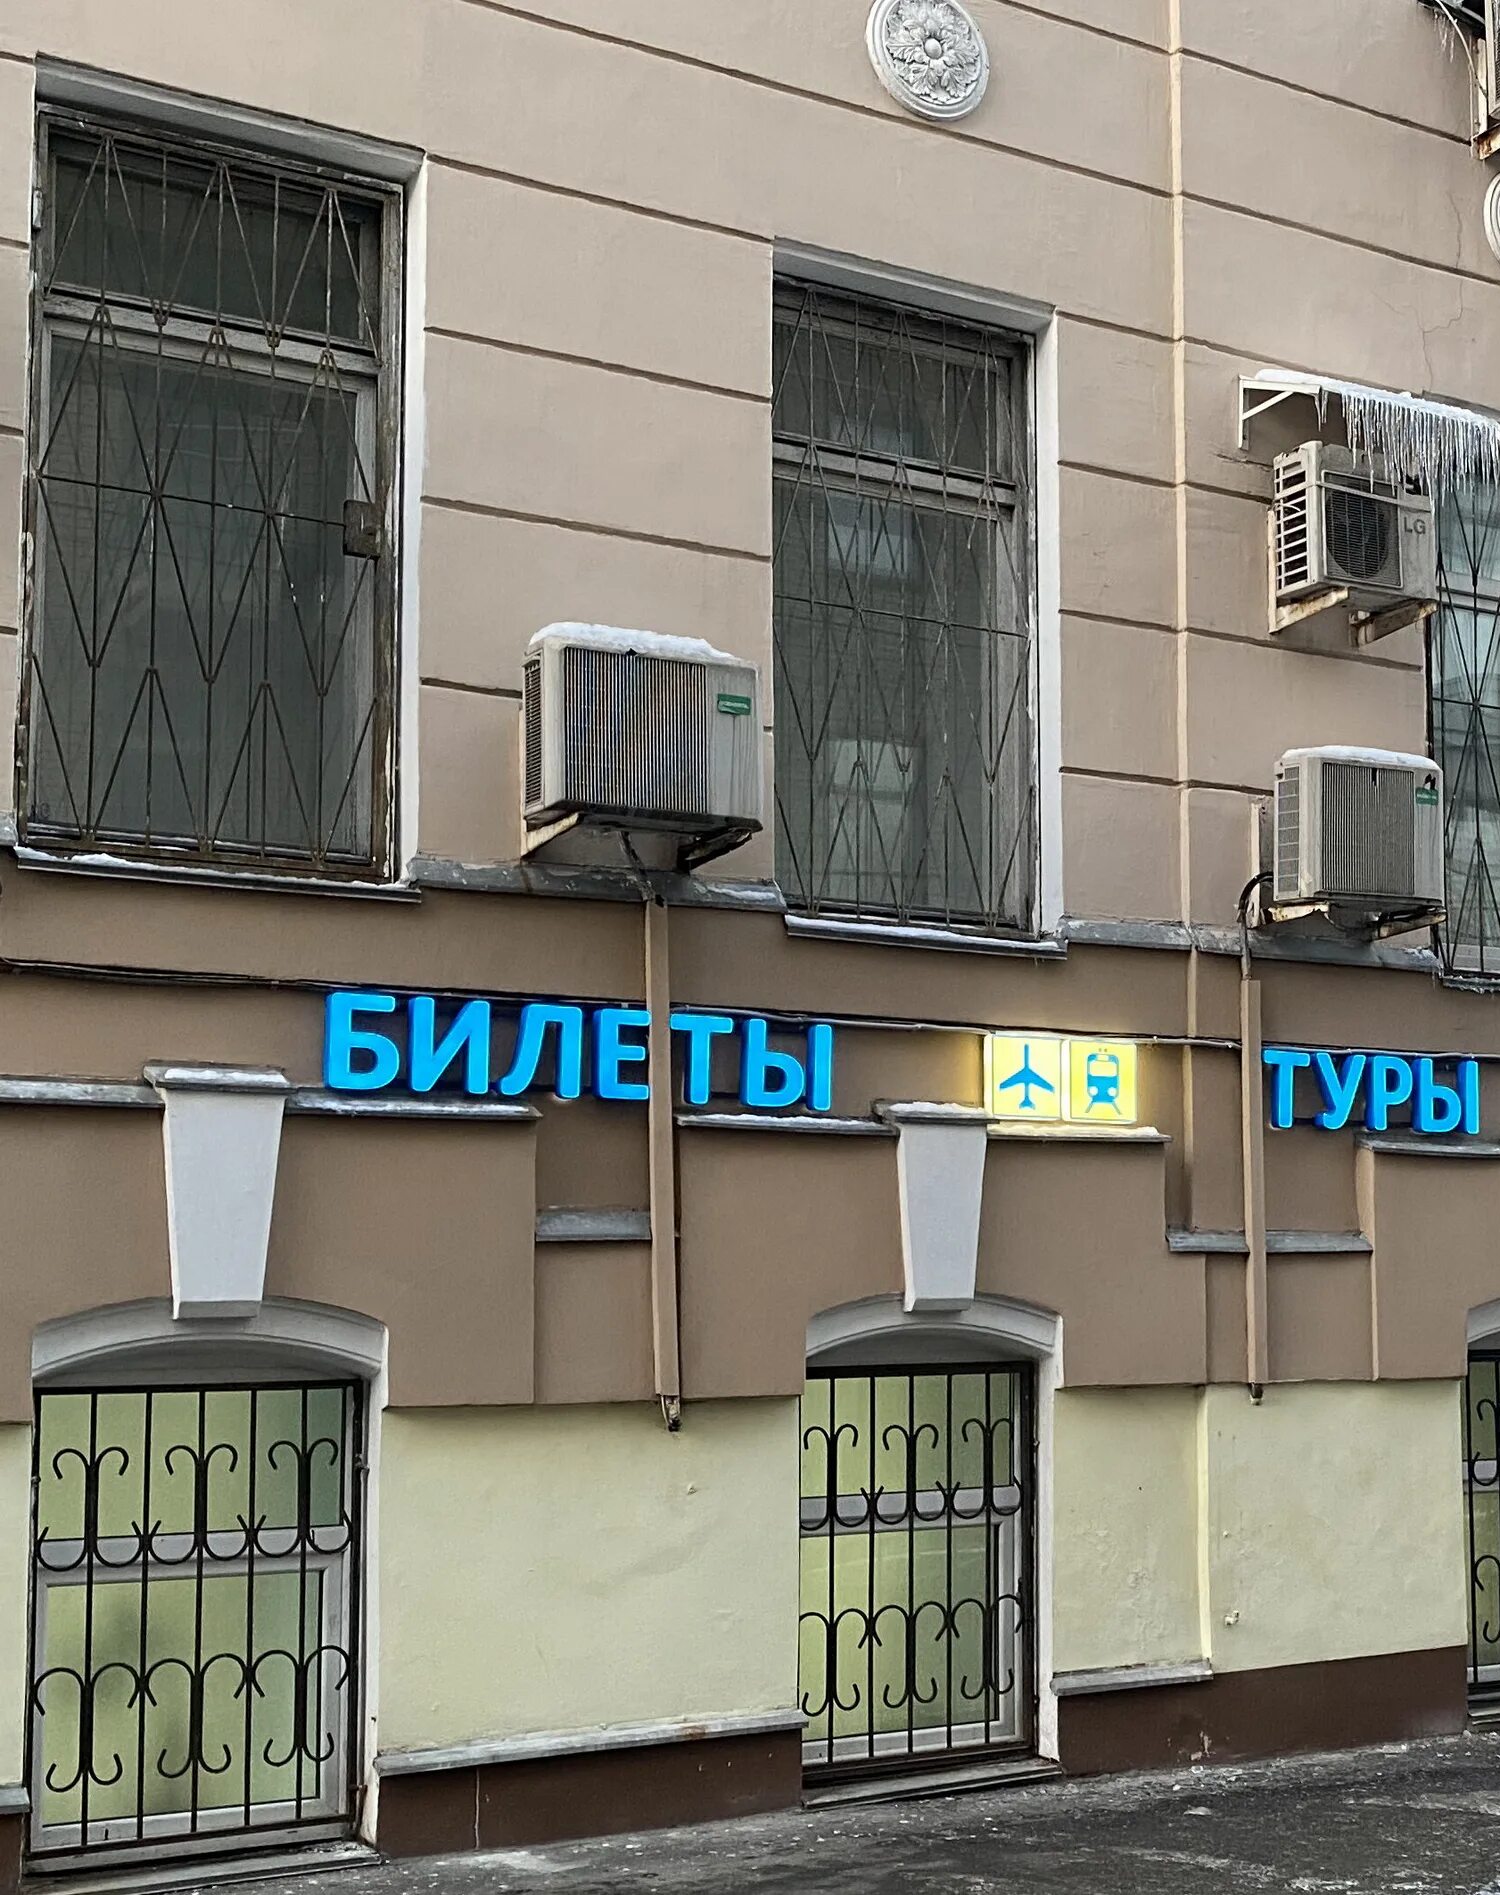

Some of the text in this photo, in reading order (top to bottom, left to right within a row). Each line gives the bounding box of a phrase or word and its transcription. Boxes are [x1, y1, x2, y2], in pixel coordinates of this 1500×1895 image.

[1403, 516, 1426, 535] LG
[324, 991, 833, 1112] БИЛЕТЫ
[1263, 1049, 1481, 1135] ТУРЫ
